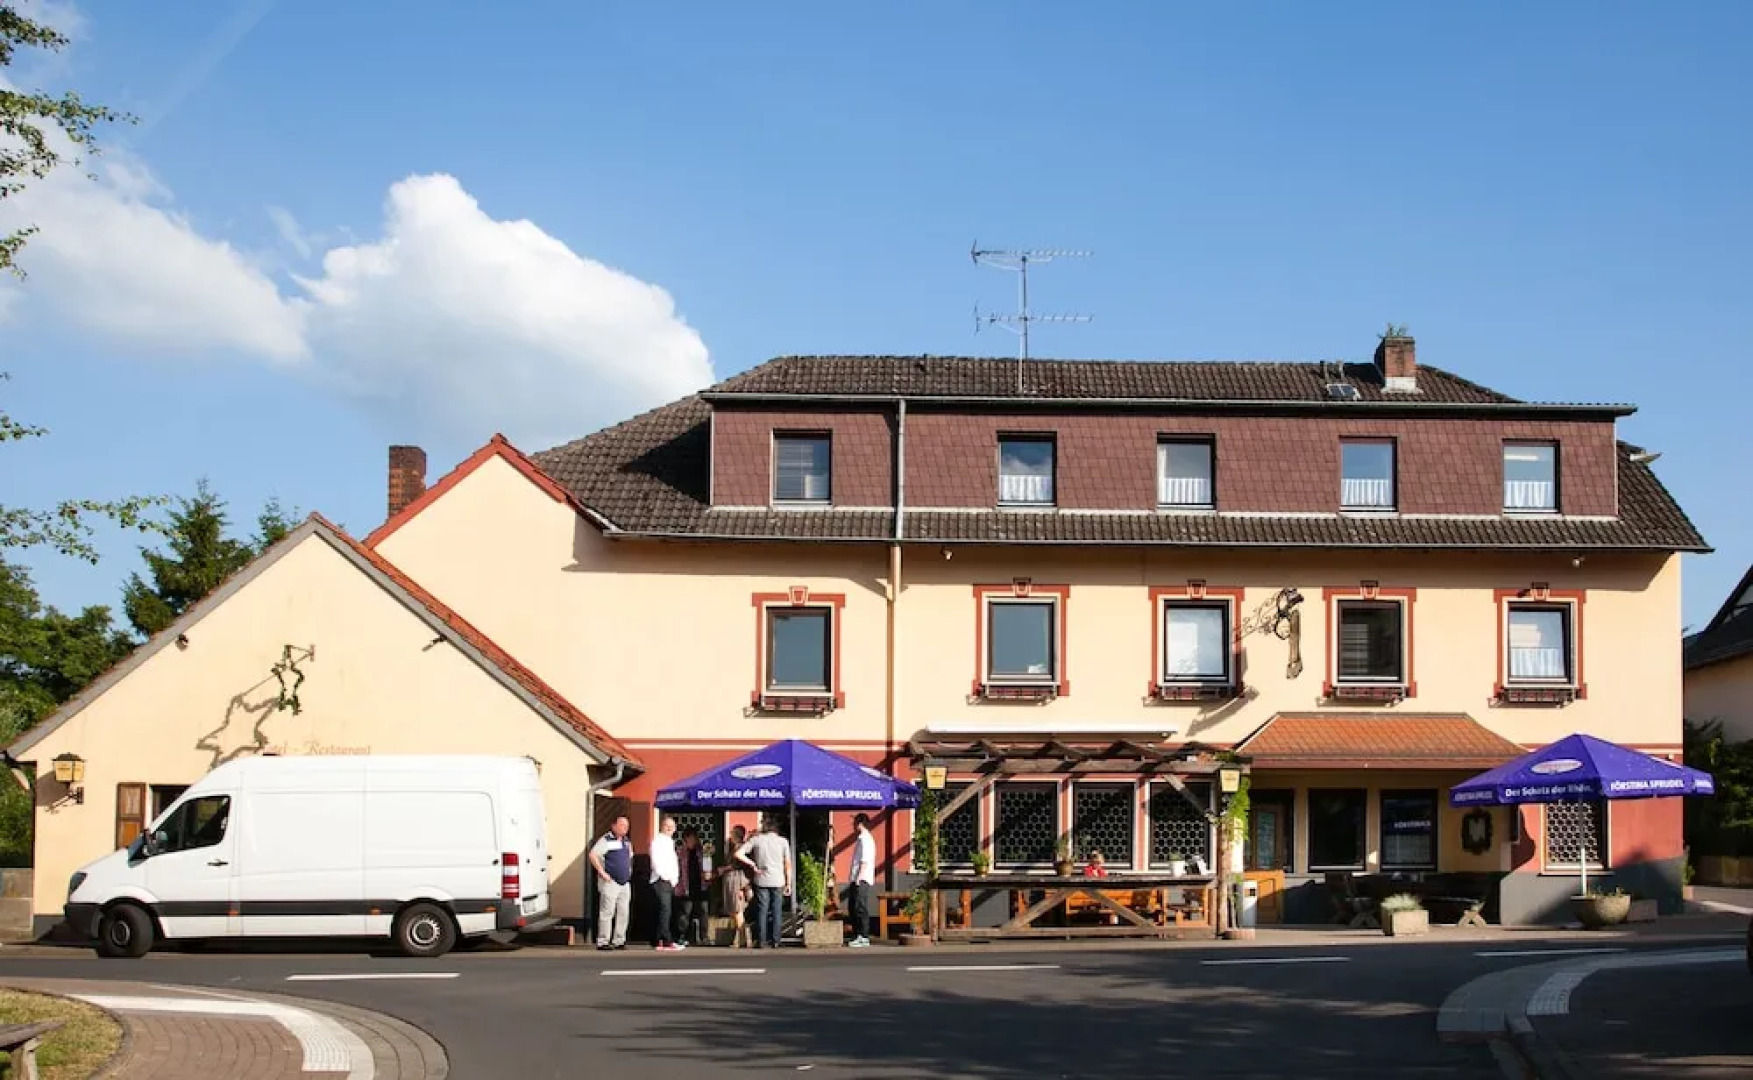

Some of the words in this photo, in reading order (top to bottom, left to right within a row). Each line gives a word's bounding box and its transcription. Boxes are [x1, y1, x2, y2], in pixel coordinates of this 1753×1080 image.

[1505, 788, 1520, 797] Der
[1521, 785, 1550, 797] Schatz
[1551, 784, 1567, 796] der
[1610, 779, 1649, 792] FÖRSTINA
[1650, 778, 1685, 789] SPRUDEL
[697, 790, 712, 799] Der
[714, 789, 741, 799] Schatz
[743, 788, 757, 799] der
[802, 788, 843, 800] FÖRSTINA
[845, 790, 883, 801] SPRUDEL
